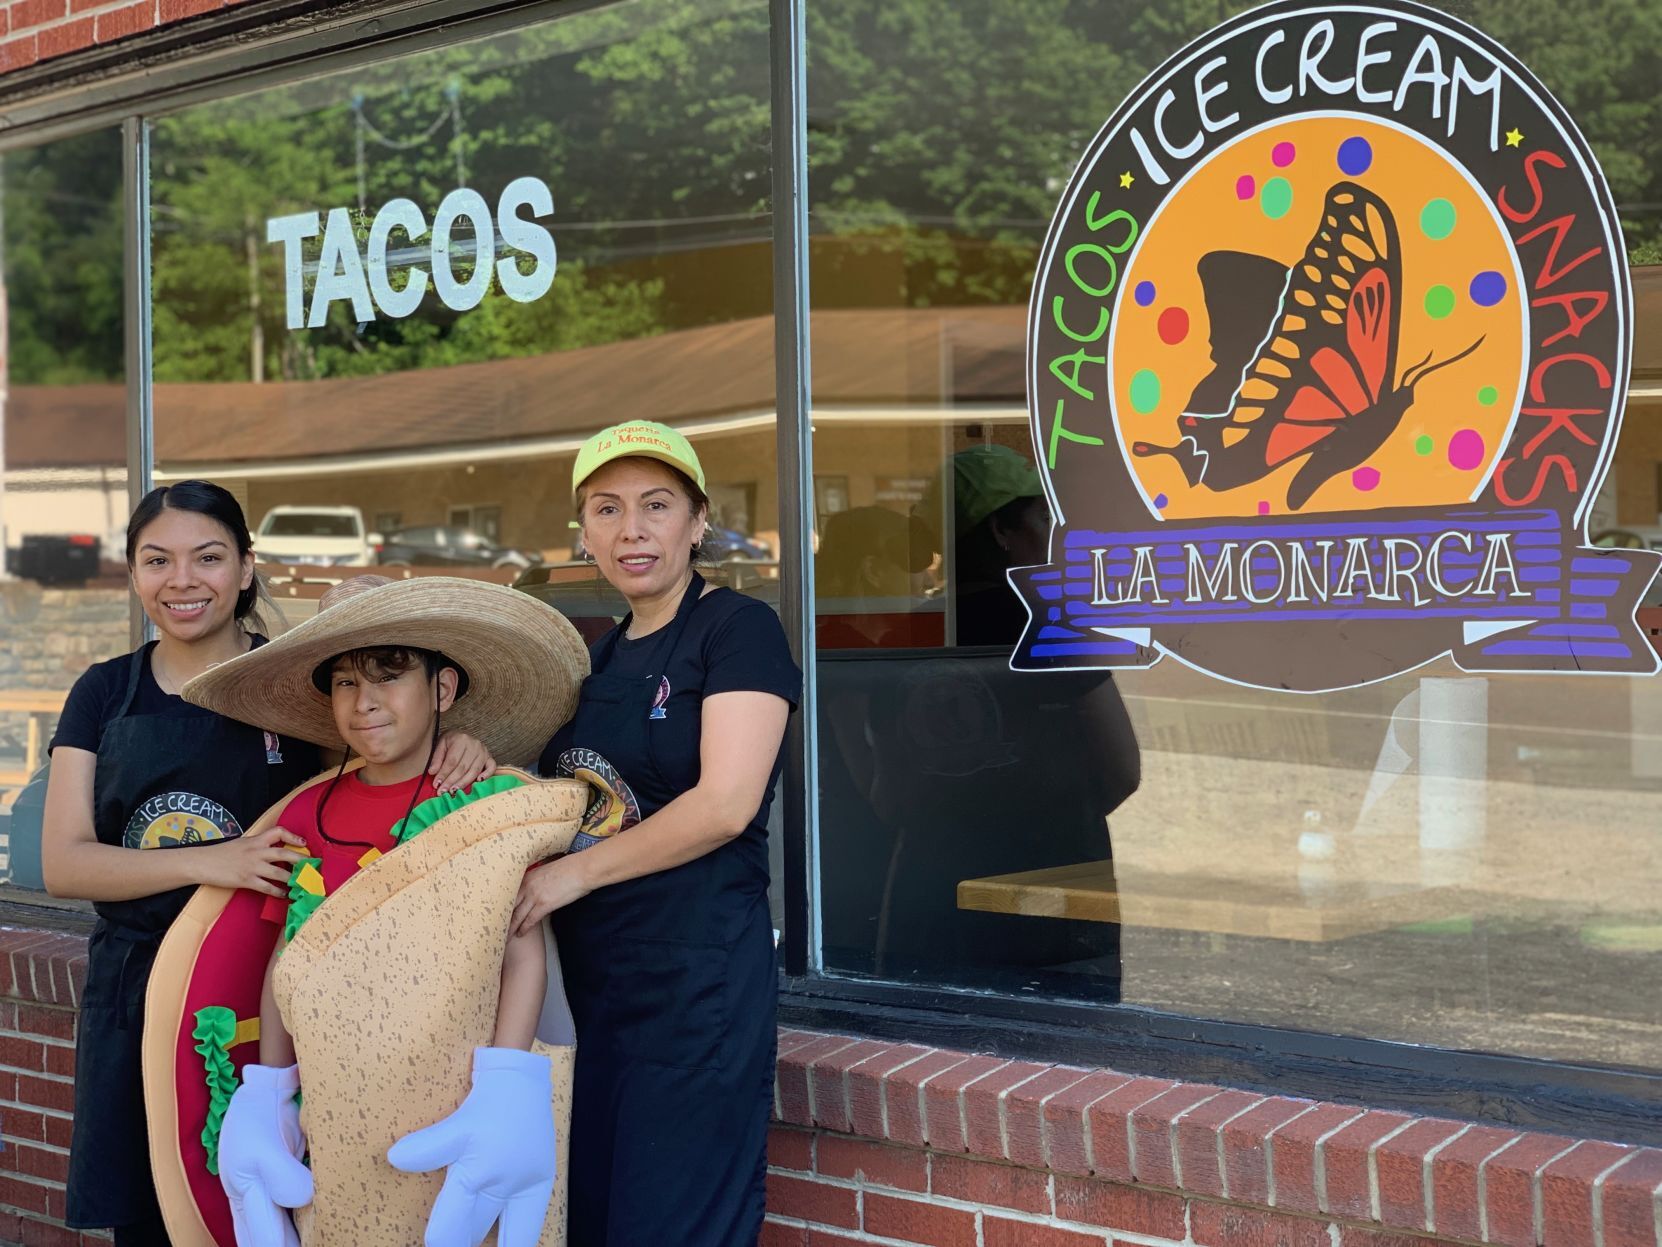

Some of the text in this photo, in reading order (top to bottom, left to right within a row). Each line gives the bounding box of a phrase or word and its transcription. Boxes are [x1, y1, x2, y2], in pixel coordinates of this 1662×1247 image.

[1130, 19, 1501, 185] ICE CREAM
[266, 175, 557, 330] TACOS
[1049, 190, 1139, 469] TACOS
[1492, 150, 1611, 507] SNACKS
[597, 434, 673, 453] La Monarca
[612, 425, 660, 436] Taqueria
[1090, 531, 1532, 607] LA MONARCA
[571, 750, 613, 780] CREAM
[140, 795, 223, 822] ICE CREAM
